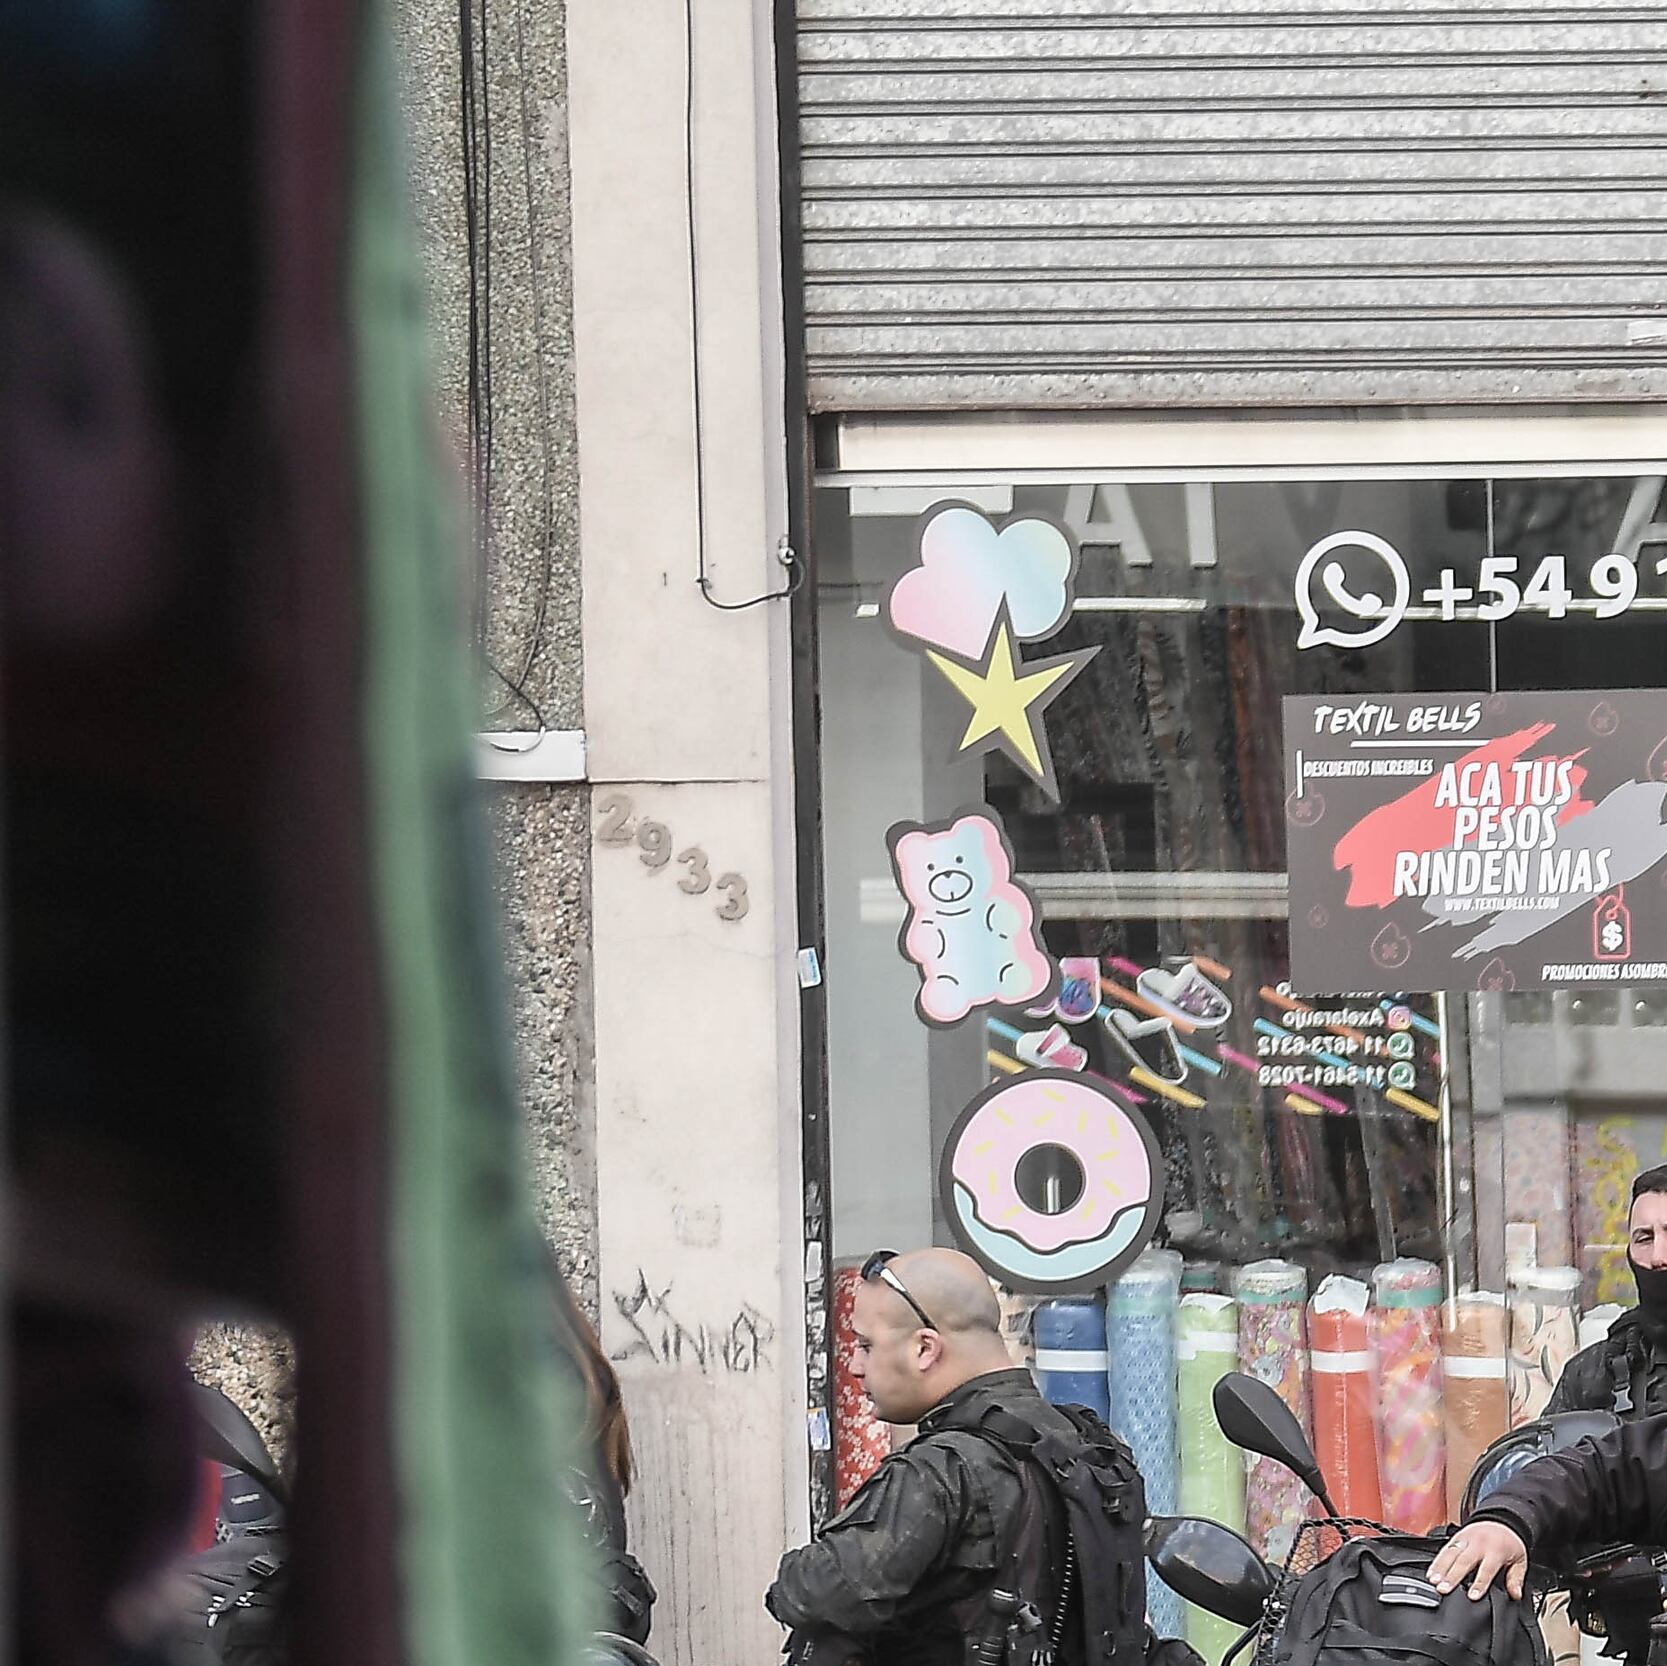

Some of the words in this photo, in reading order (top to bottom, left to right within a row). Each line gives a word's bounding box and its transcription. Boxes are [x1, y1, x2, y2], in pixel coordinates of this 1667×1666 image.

[1314, 700, 1400, 736] TEXTIL
[1406, 701, 1481, 733] BELLS
[1303, 760, 1370, 779] DESCUENTOS
[1371, 758, 1434, 777] INCREIBLES
[1434, 761, 1503, 808] ACA
[1512, 759, 1574, 806] TUS
[1453, 805, 1559, 851] PESOS
[597, 793, 750, 921] 2933
[1393, 848, 1529, 897] RINDEN
[1537, 846, 1613, 895] MAS
[1541, 963, 1620, 982] PROMOCIONES
